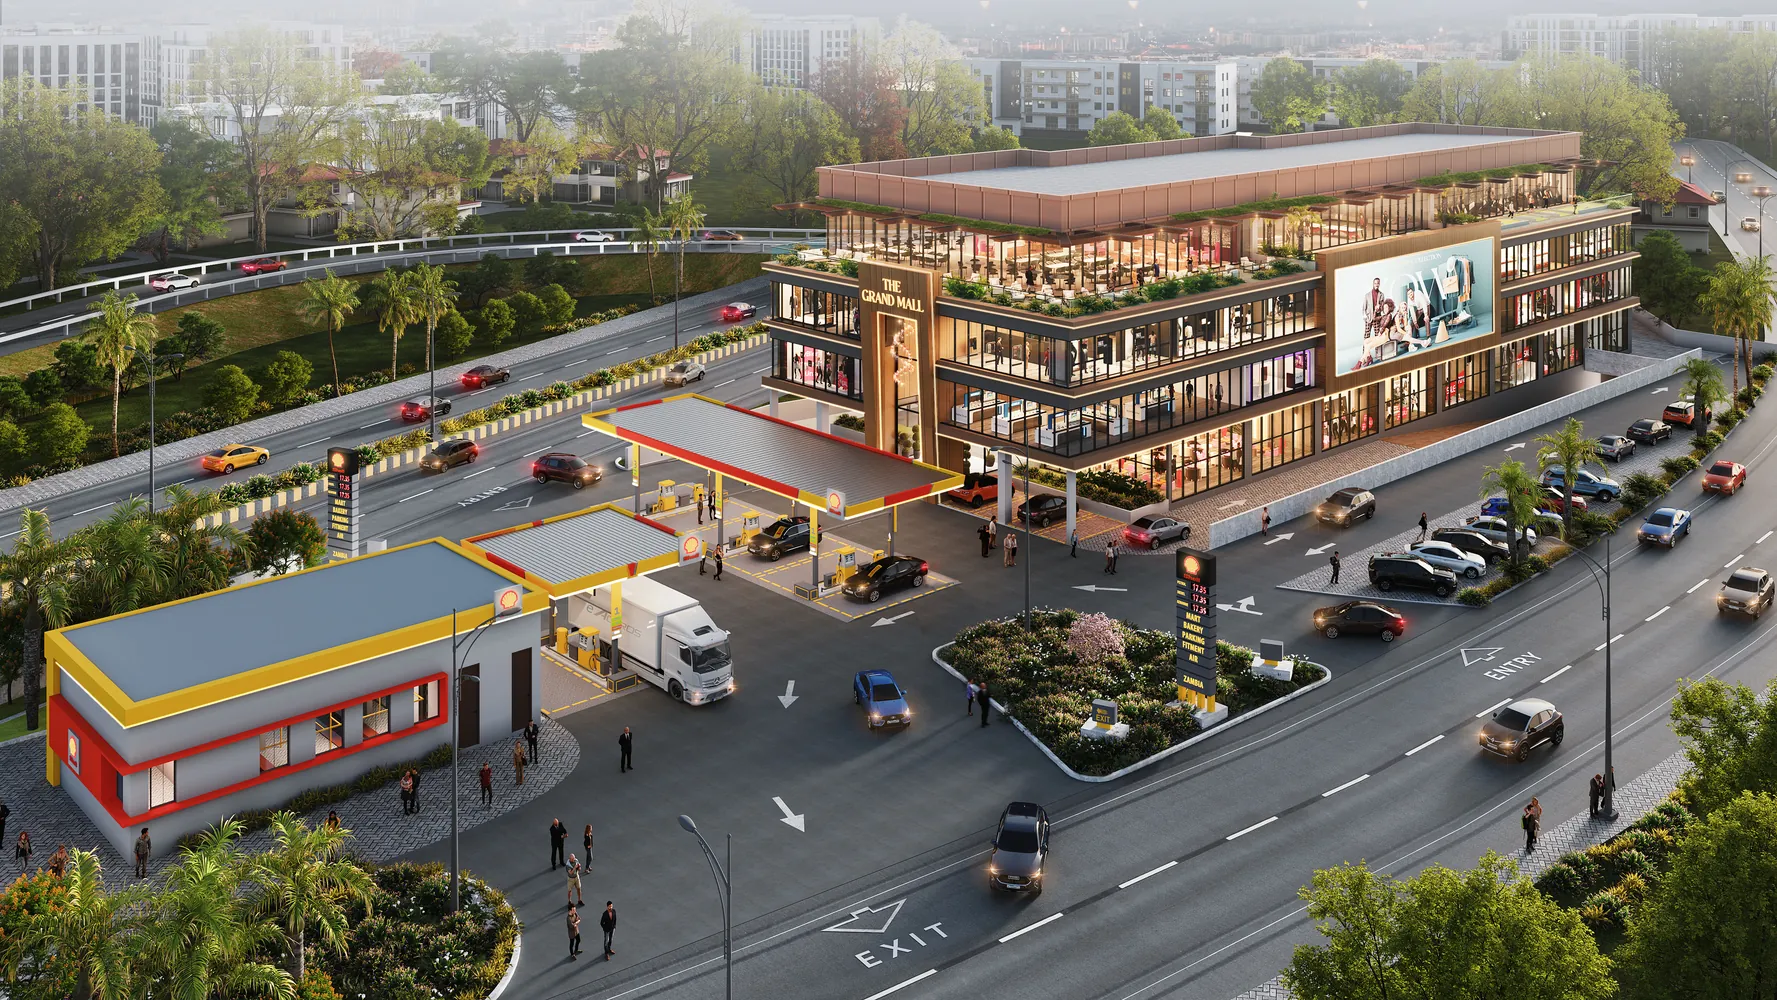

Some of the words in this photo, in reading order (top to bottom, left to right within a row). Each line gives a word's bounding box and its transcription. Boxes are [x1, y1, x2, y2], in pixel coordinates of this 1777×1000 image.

[882, 278, 902, 294] THE
[861, 288, 895, 306] GRAND
[896, 296, 924, 313] MALL
[458, 486, 508, 507] ENTRY
[332, 514, 348, 523] PARKING
[1192, 583, 1207, 594] 17.35
[1192, 594, 1207, 604] 17.35
[1192, 604, 1207, 614] 17.35
[1186, 612, 1201, 623] MART
[1183, 621, 1204, 634] BAKERY
[1182, 631, 1205, 645] PARKING
[1182, 641, 1204, 655] FITMENT
[1188, 654, 1198, 663] AIR
[1483, 651, 1542, 680] ENTRY
[1183, 674, 1204, 689] ZAMBIA
[1096, 714, 1110, 723] EXIT
[854, 922, 948, 969] EXIT
